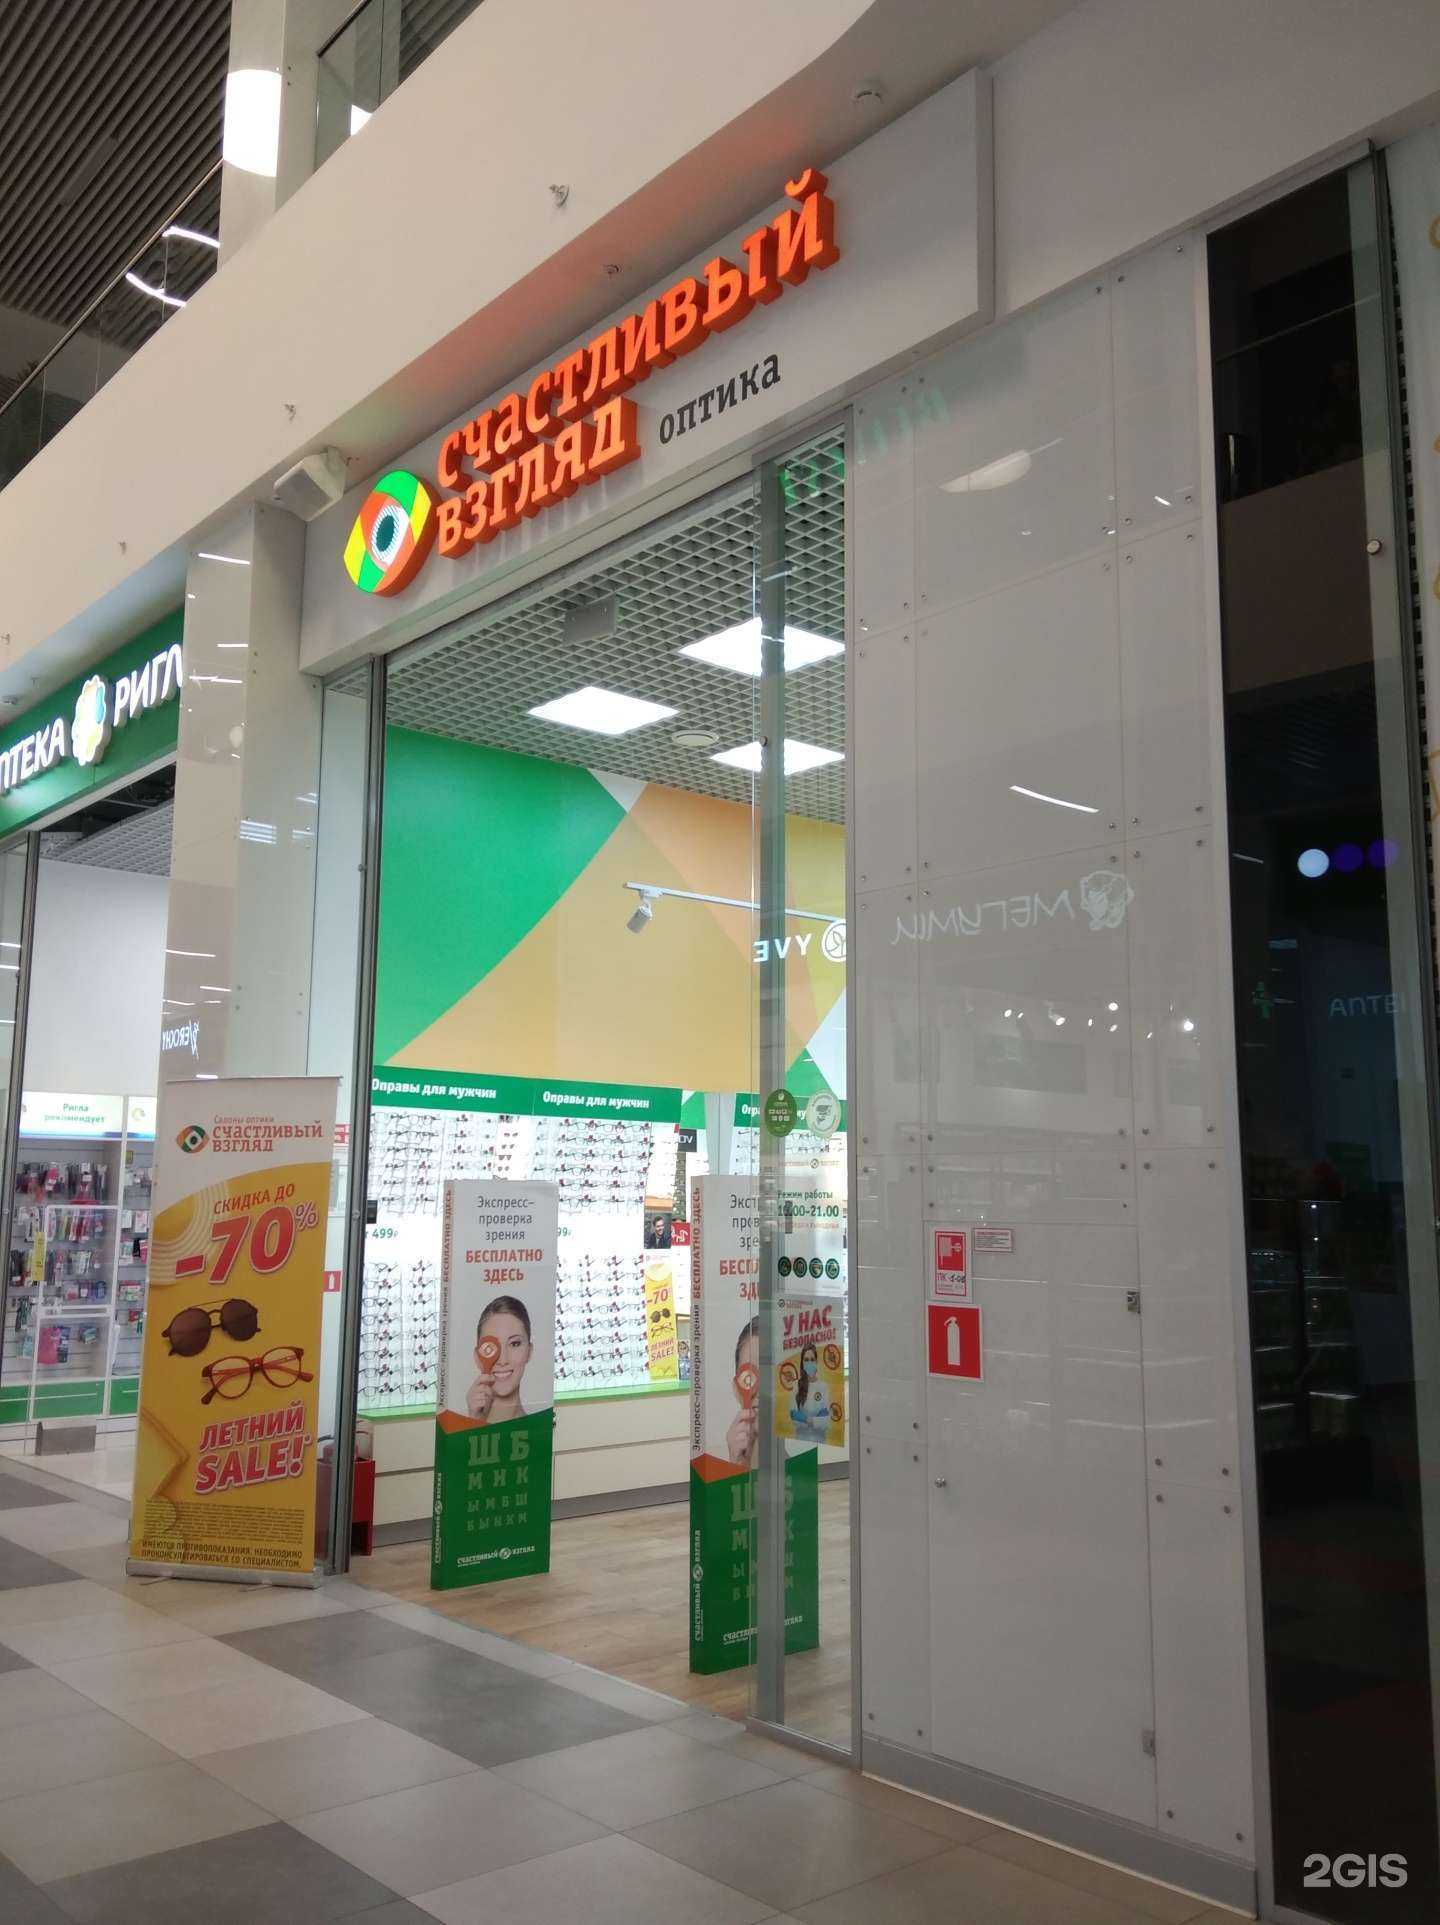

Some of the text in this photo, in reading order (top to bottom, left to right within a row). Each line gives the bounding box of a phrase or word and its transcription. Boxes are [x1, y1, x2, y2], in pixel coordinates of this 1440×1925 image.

[437, 168, 840, 492] СЧАСТЛИВЫЙ
[659, 353, 782, 445] оптика
[437, 395, 641, 559] ВЗГЛЯД
[372, 1078, 497, 1100] Оправы для мужчин
[542, 1090, 650, 1110] Оправы для мужчин
[212, 1139, 274, 1153] ВЗГЛЯД
[213, 1182, 296, 1215] СКИДКА ДО
[477, 1195, 535, 1210] Экспресс-
[478, 1211, 533, 1226] проверка
[485, 1229, 526, 1242] зрения
[465, 1248, 543, 1264] БЕСПЛАТНО
[693, 1227, 703, 1300] БЕСПЛАТНО
[483, 1267, 525, 1285] ЗДЕСЬ
[783, 1304, 833, 1337] У НАС
[199, 1401, 306, 1452] ЛЕТНИЙ
[194, 1433, 306, 1494] SALE!
[468, 1429, 530, 1467] Ш Б
